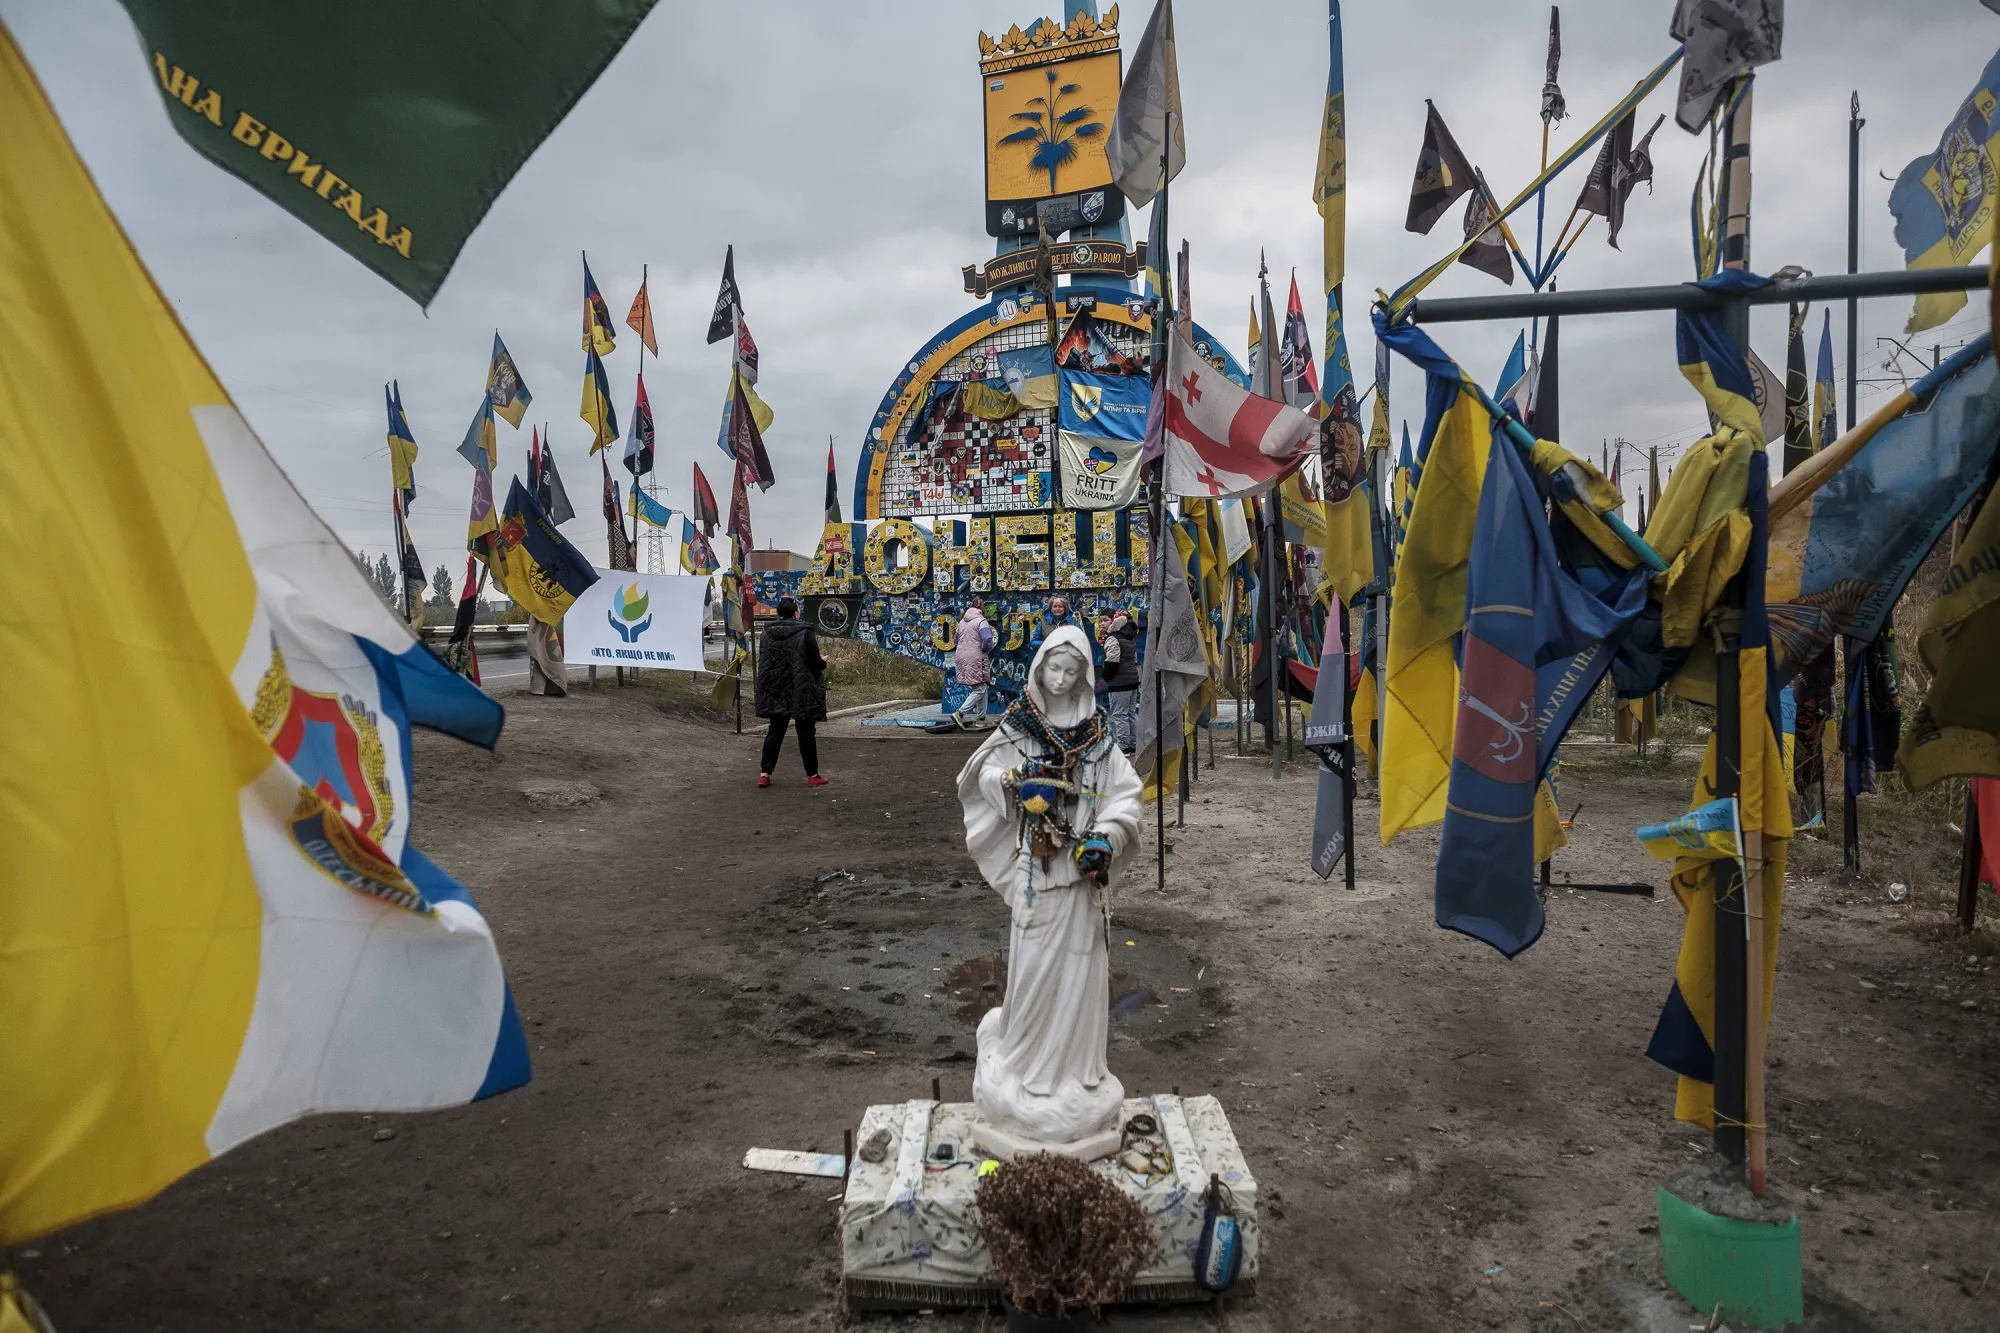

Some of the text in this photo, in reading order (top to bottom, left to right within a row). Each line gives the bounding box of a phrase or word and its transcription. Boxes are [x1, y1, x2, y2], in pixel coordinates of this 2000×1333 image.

[231, 111, 414, 260] БРИГАДА
[1090, 252, 1121, 264] РАВОЮ
[1032, 473, 1040, 502] VIRTUS
[1077, 474, 1118, 492] FRITT
[1075, 487, 1116, 502] UKRAINA
[615, 648, 643, 661] ЯКЩО
[645, 650, 656, 661] НЕ
